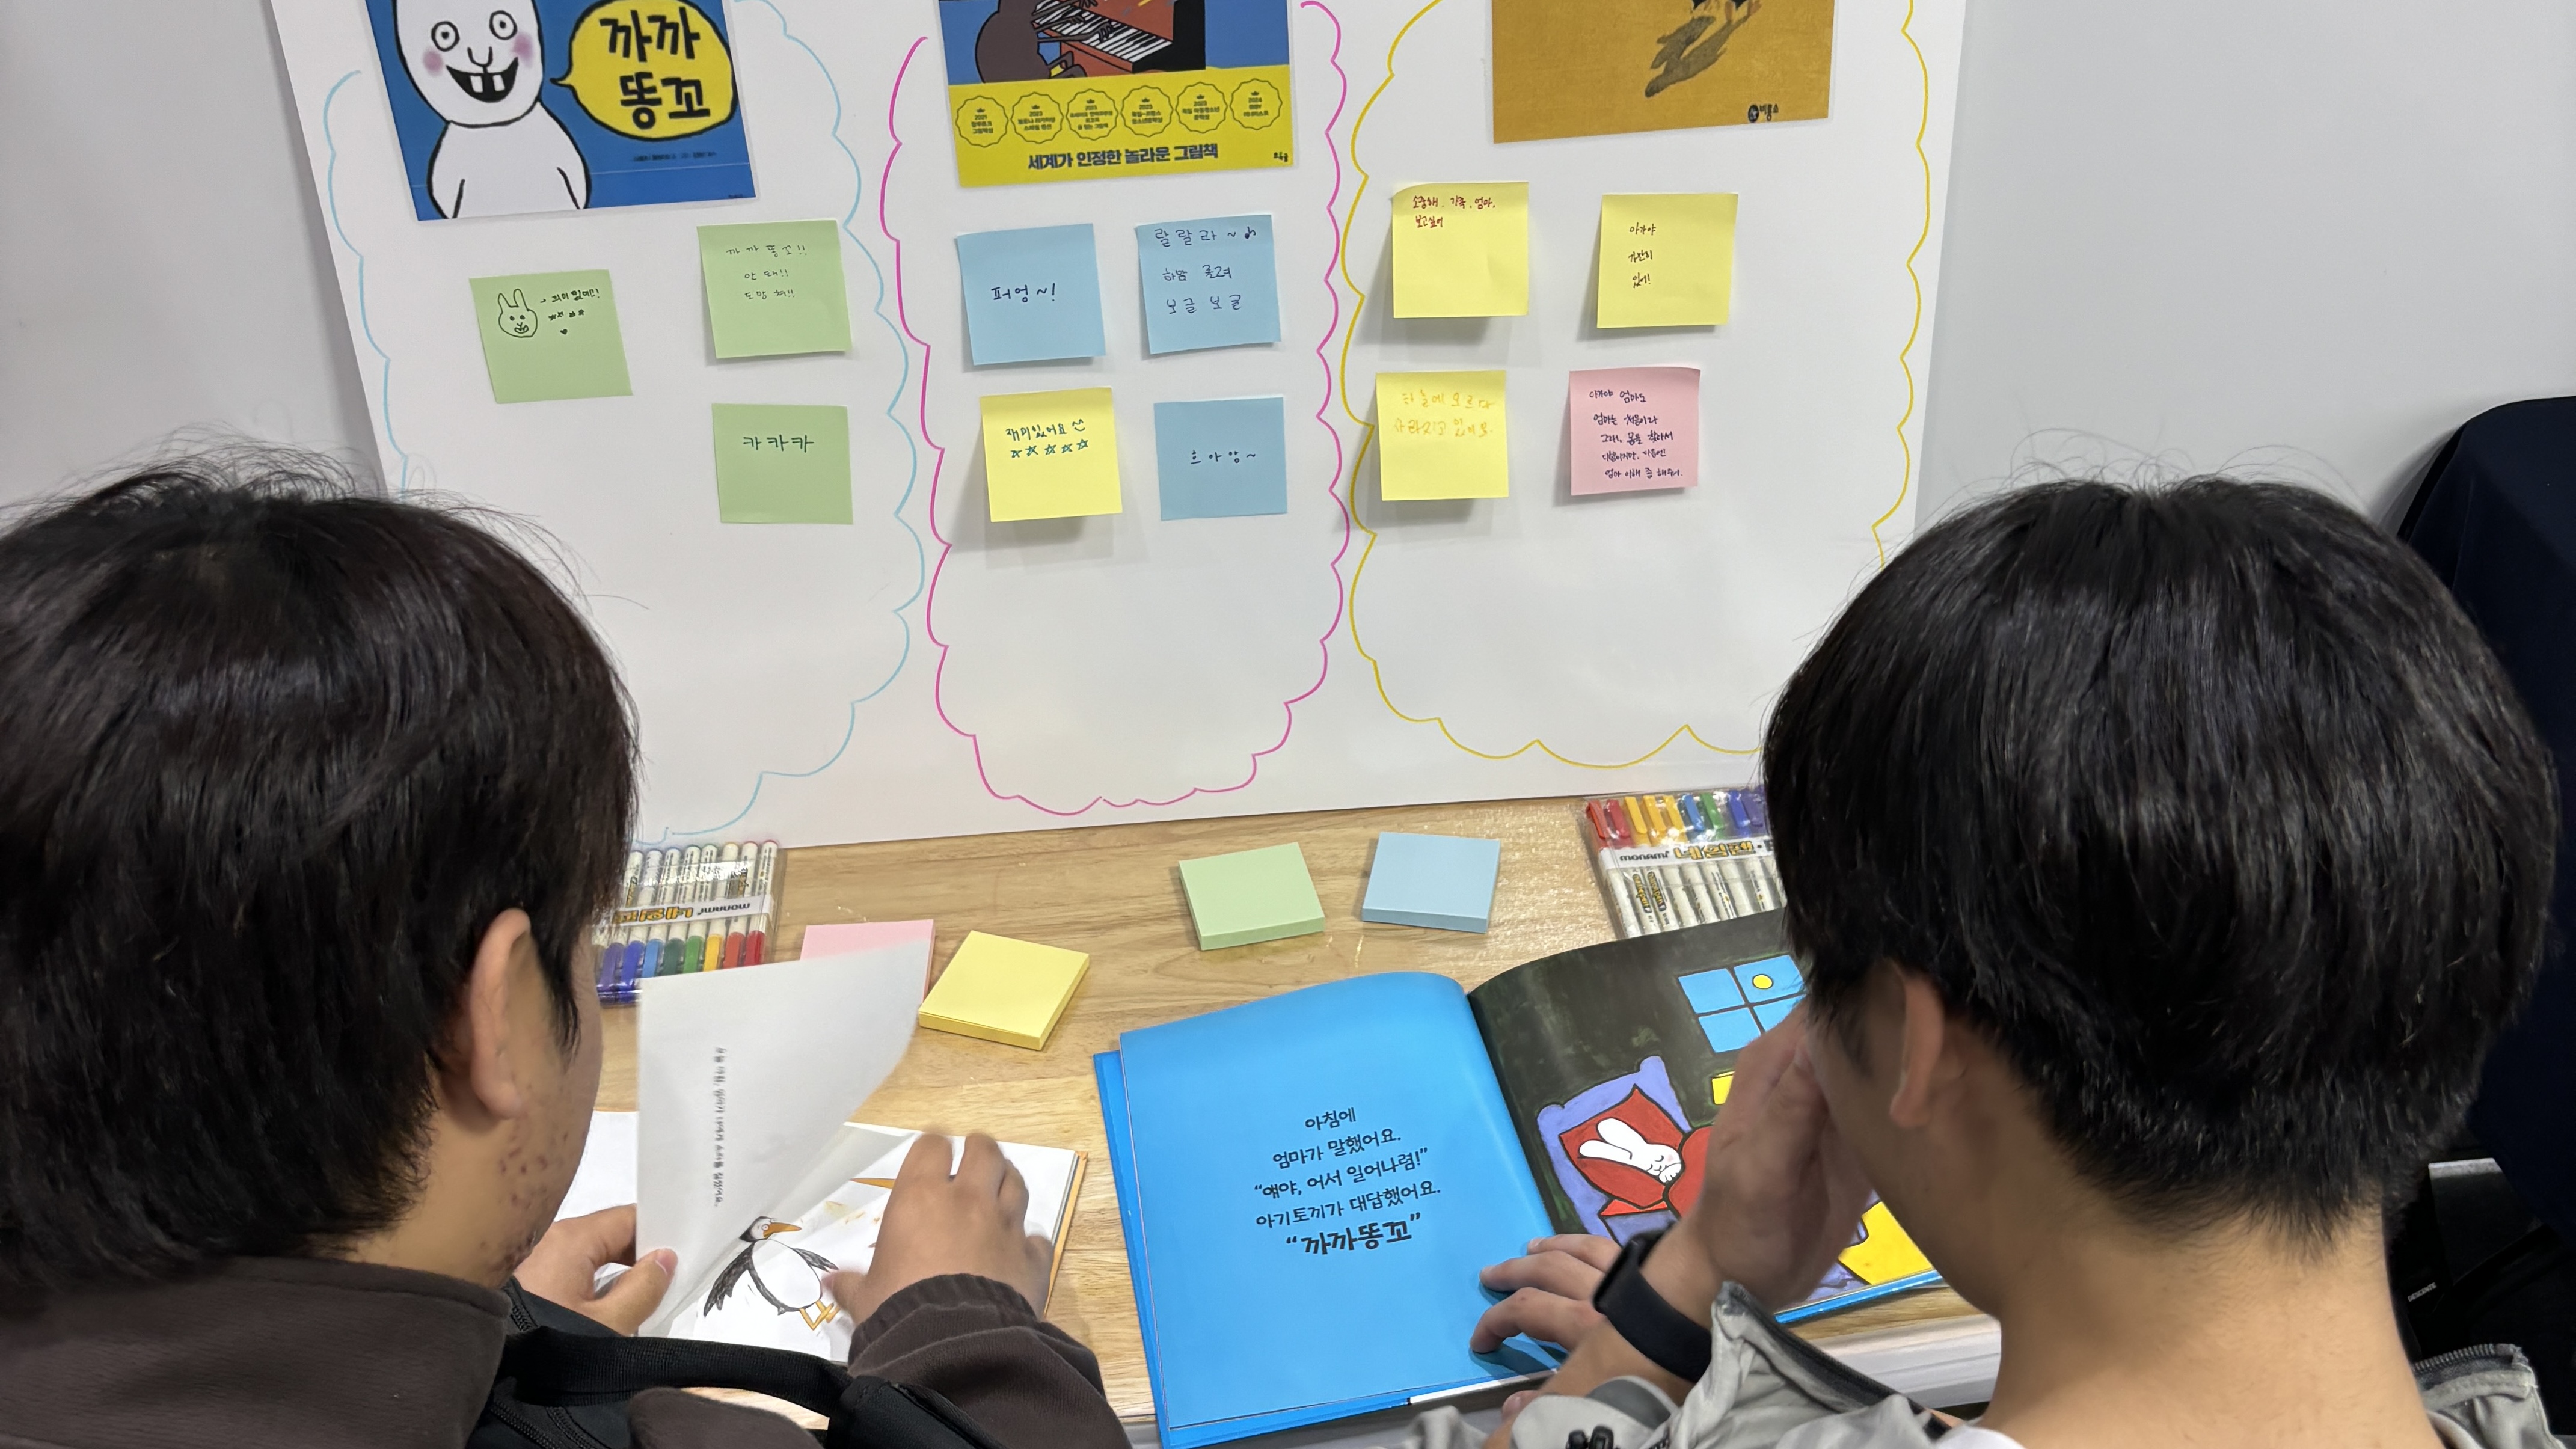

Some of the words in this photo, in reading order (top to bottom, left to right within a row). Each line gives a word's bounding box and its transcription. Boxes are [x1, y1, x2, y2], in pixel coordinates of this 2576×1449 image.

[596, 2, 703, 63] 까까
[616, 71, 713, 132] 똥꼬
[1028, 152, 1074, 170] 세계가
[1076, 149, 1123, 167] 인정한
[1124, 146, 1171, 164] 놀라운
[1173, 142, 1219, 161] 그림책
[744, 272, 757, 281] 안
[1202, 264, 1232, 279] 졸려
[1589, 388, 1614, 399] 아가야
[1619, 390, 1646, 404] 엄마도
[1593, 412, 1618, 426] 엄마는
[1624, 414, 1658, 426] 처음이라
[1005, 423, 1067, 442] 재미있어요
[1626, 432, 1643, 446] 몸을
[1647, 429, 1673, 443] 찾아서
[1642, 448, 1666, 458] 다음엔
[1604, 468, 1622, 479] 엄마
[1624, 468, 1641, 479] 이해
[1619, 850, 1670, 862] monami
[1305, 1107, 1357, 1131] 아침에
[1272, 1145, 1325, 1169] 엄마가
[1328, 1128, 1402, 1156] 말했어요.
[1254, 1180, 1302, 1199] “얘야,
[1307, 1169, 1343, 1190] 어서
[1346, 1147, 1428, 1183] 일어나렴!”
[1256, 1201, 1345, 1228] 아기토끼가
[1349, 1180, 1441, 1212] 대답했어요.
[1286, 1212, 1421, 1255] “까까똥꼬”
